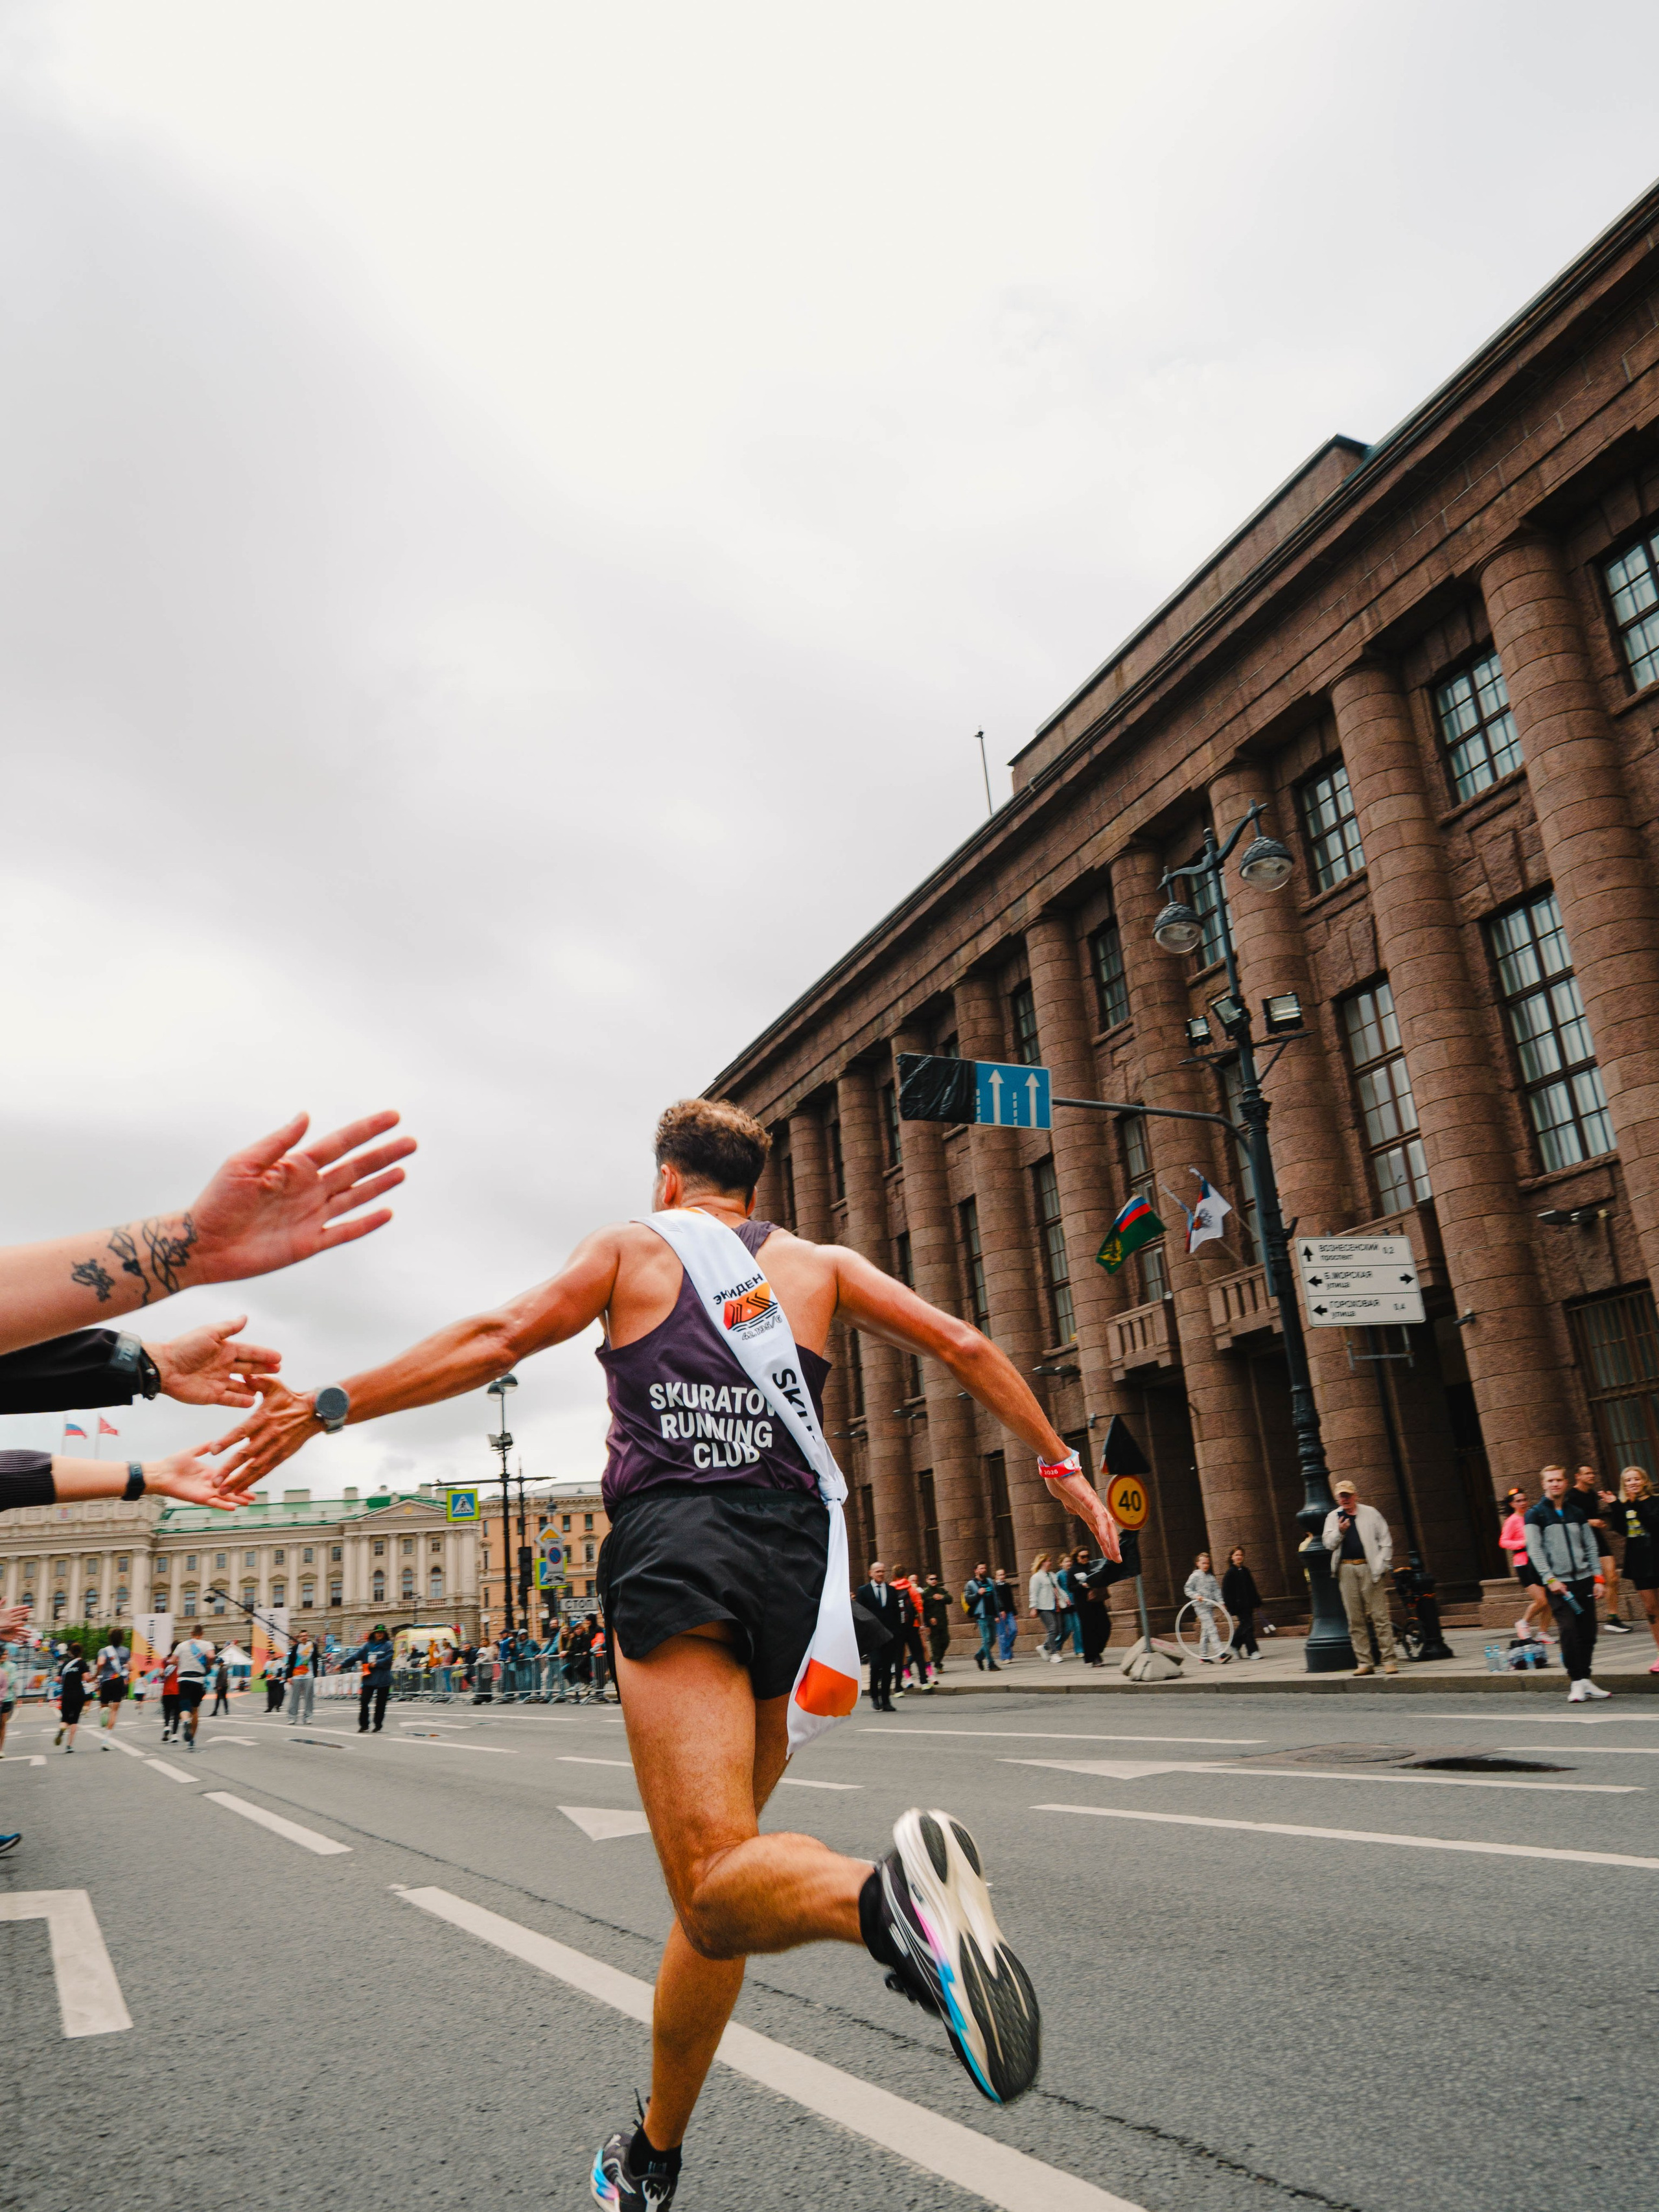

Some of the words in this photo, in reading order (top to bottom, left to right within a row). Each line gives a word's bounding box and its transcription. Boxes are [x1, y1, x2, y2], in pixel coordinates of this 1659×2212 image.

[1319, 1242, 1379, 1252] ВОЗНЕСЕНСКИЙ
[713, 1274, 763, 1305] ЭКИДЕН
[1330, 1299, 1380, 1308] ГОРОХОВАЯ
[1331, 1310, 1356, 1319] улица
[660, 1412, 772, 1448] RUNNING
[693, 1441, 760, 1469] CLUB
[1119, 1490, 1142, 1511] 40
[564, 1599, 594, 1609] СТОП
